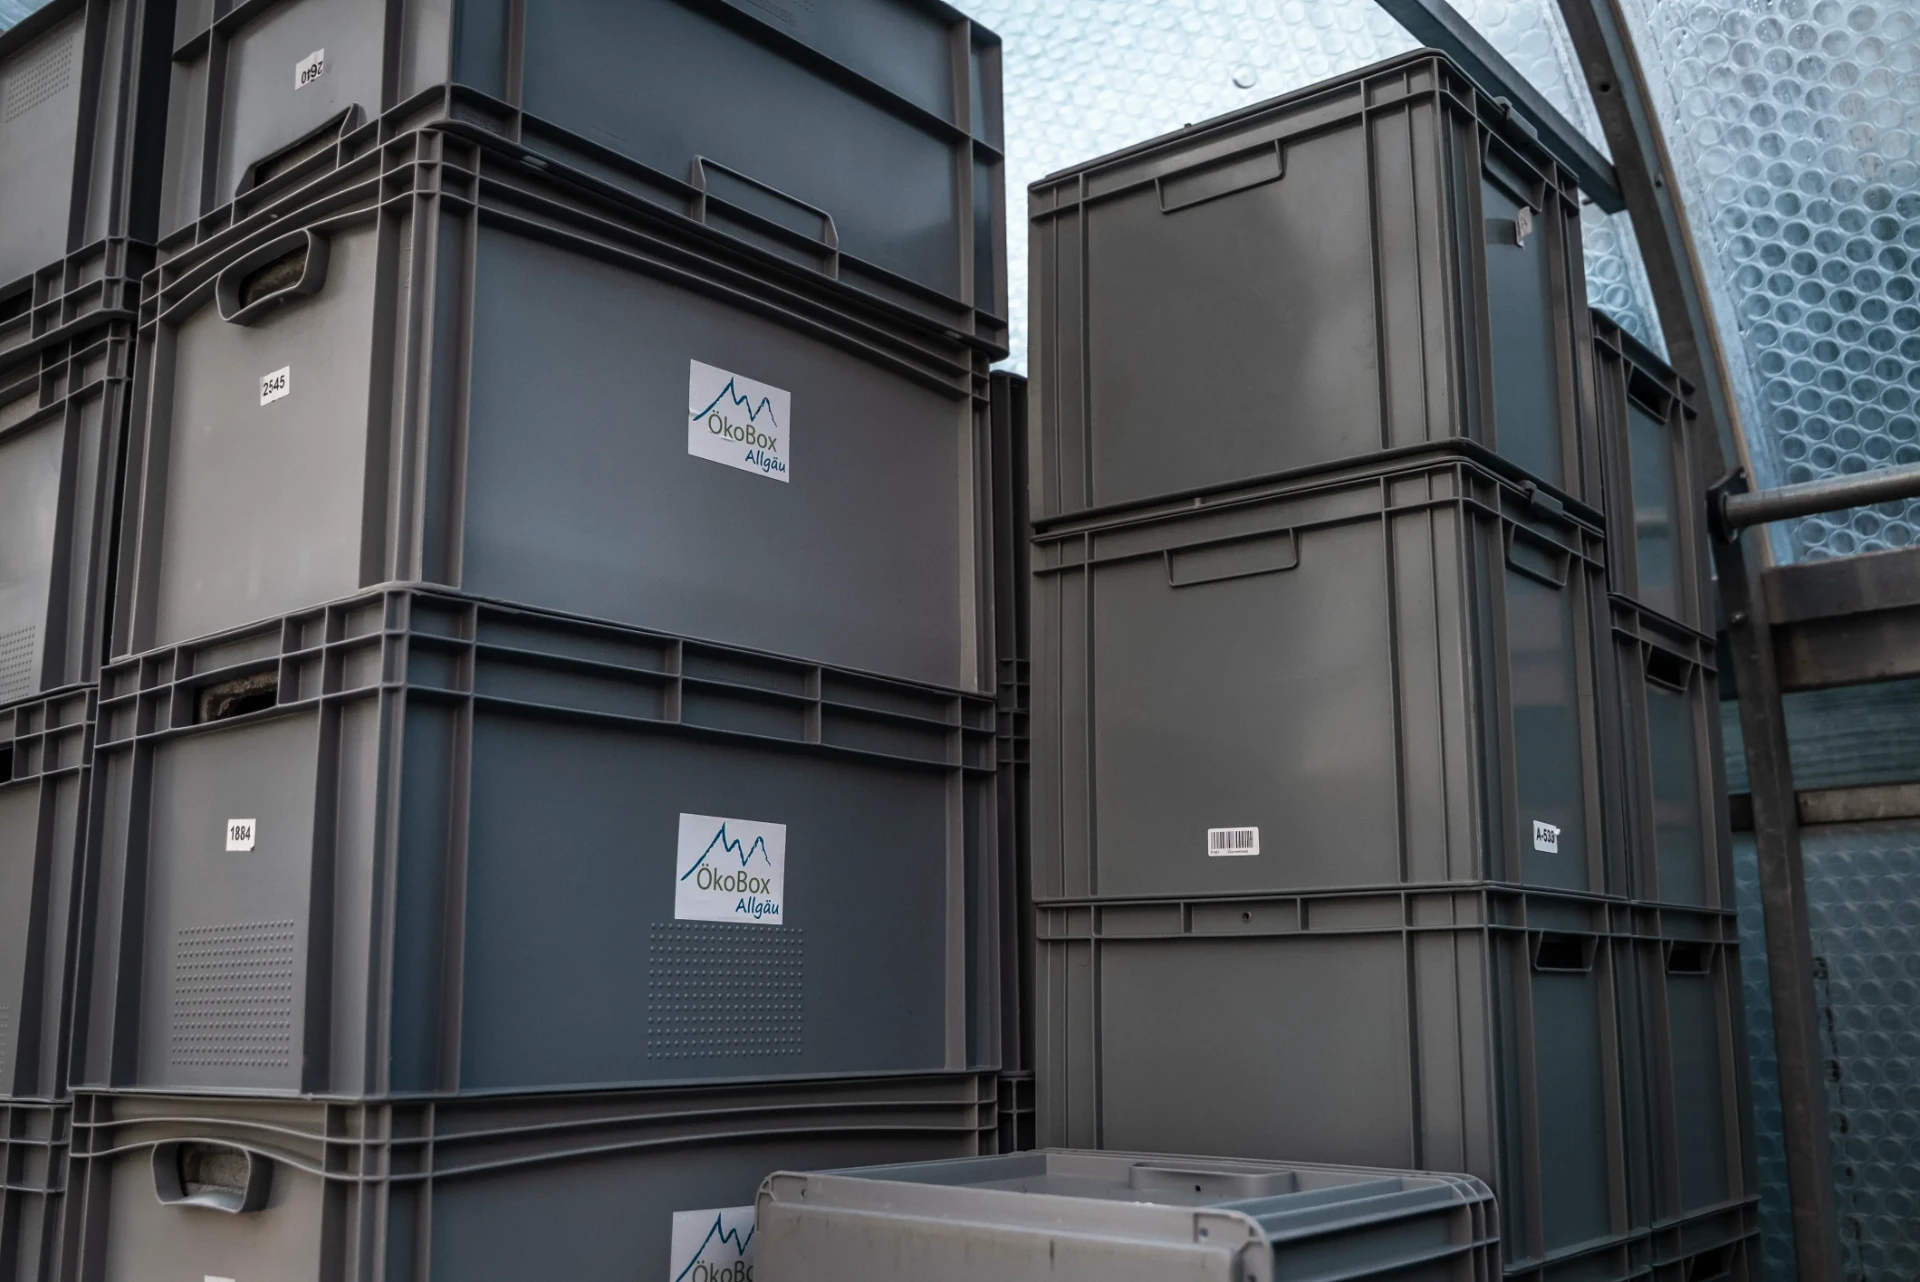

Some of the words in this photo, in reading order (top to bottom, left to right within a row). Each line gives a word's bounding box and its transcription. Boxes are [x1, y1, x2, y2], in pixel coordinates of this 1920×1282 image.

[263, 374, 285, 397] 2545
[708, 409, 777, 452] ÖkoBox
[745, 449, 785, 473] Allgäu
[230, 825, 251, 841] 1884
[697, 863, 771, 895] ÖkoBox
[735, 896, 779, 919] Allgäu
